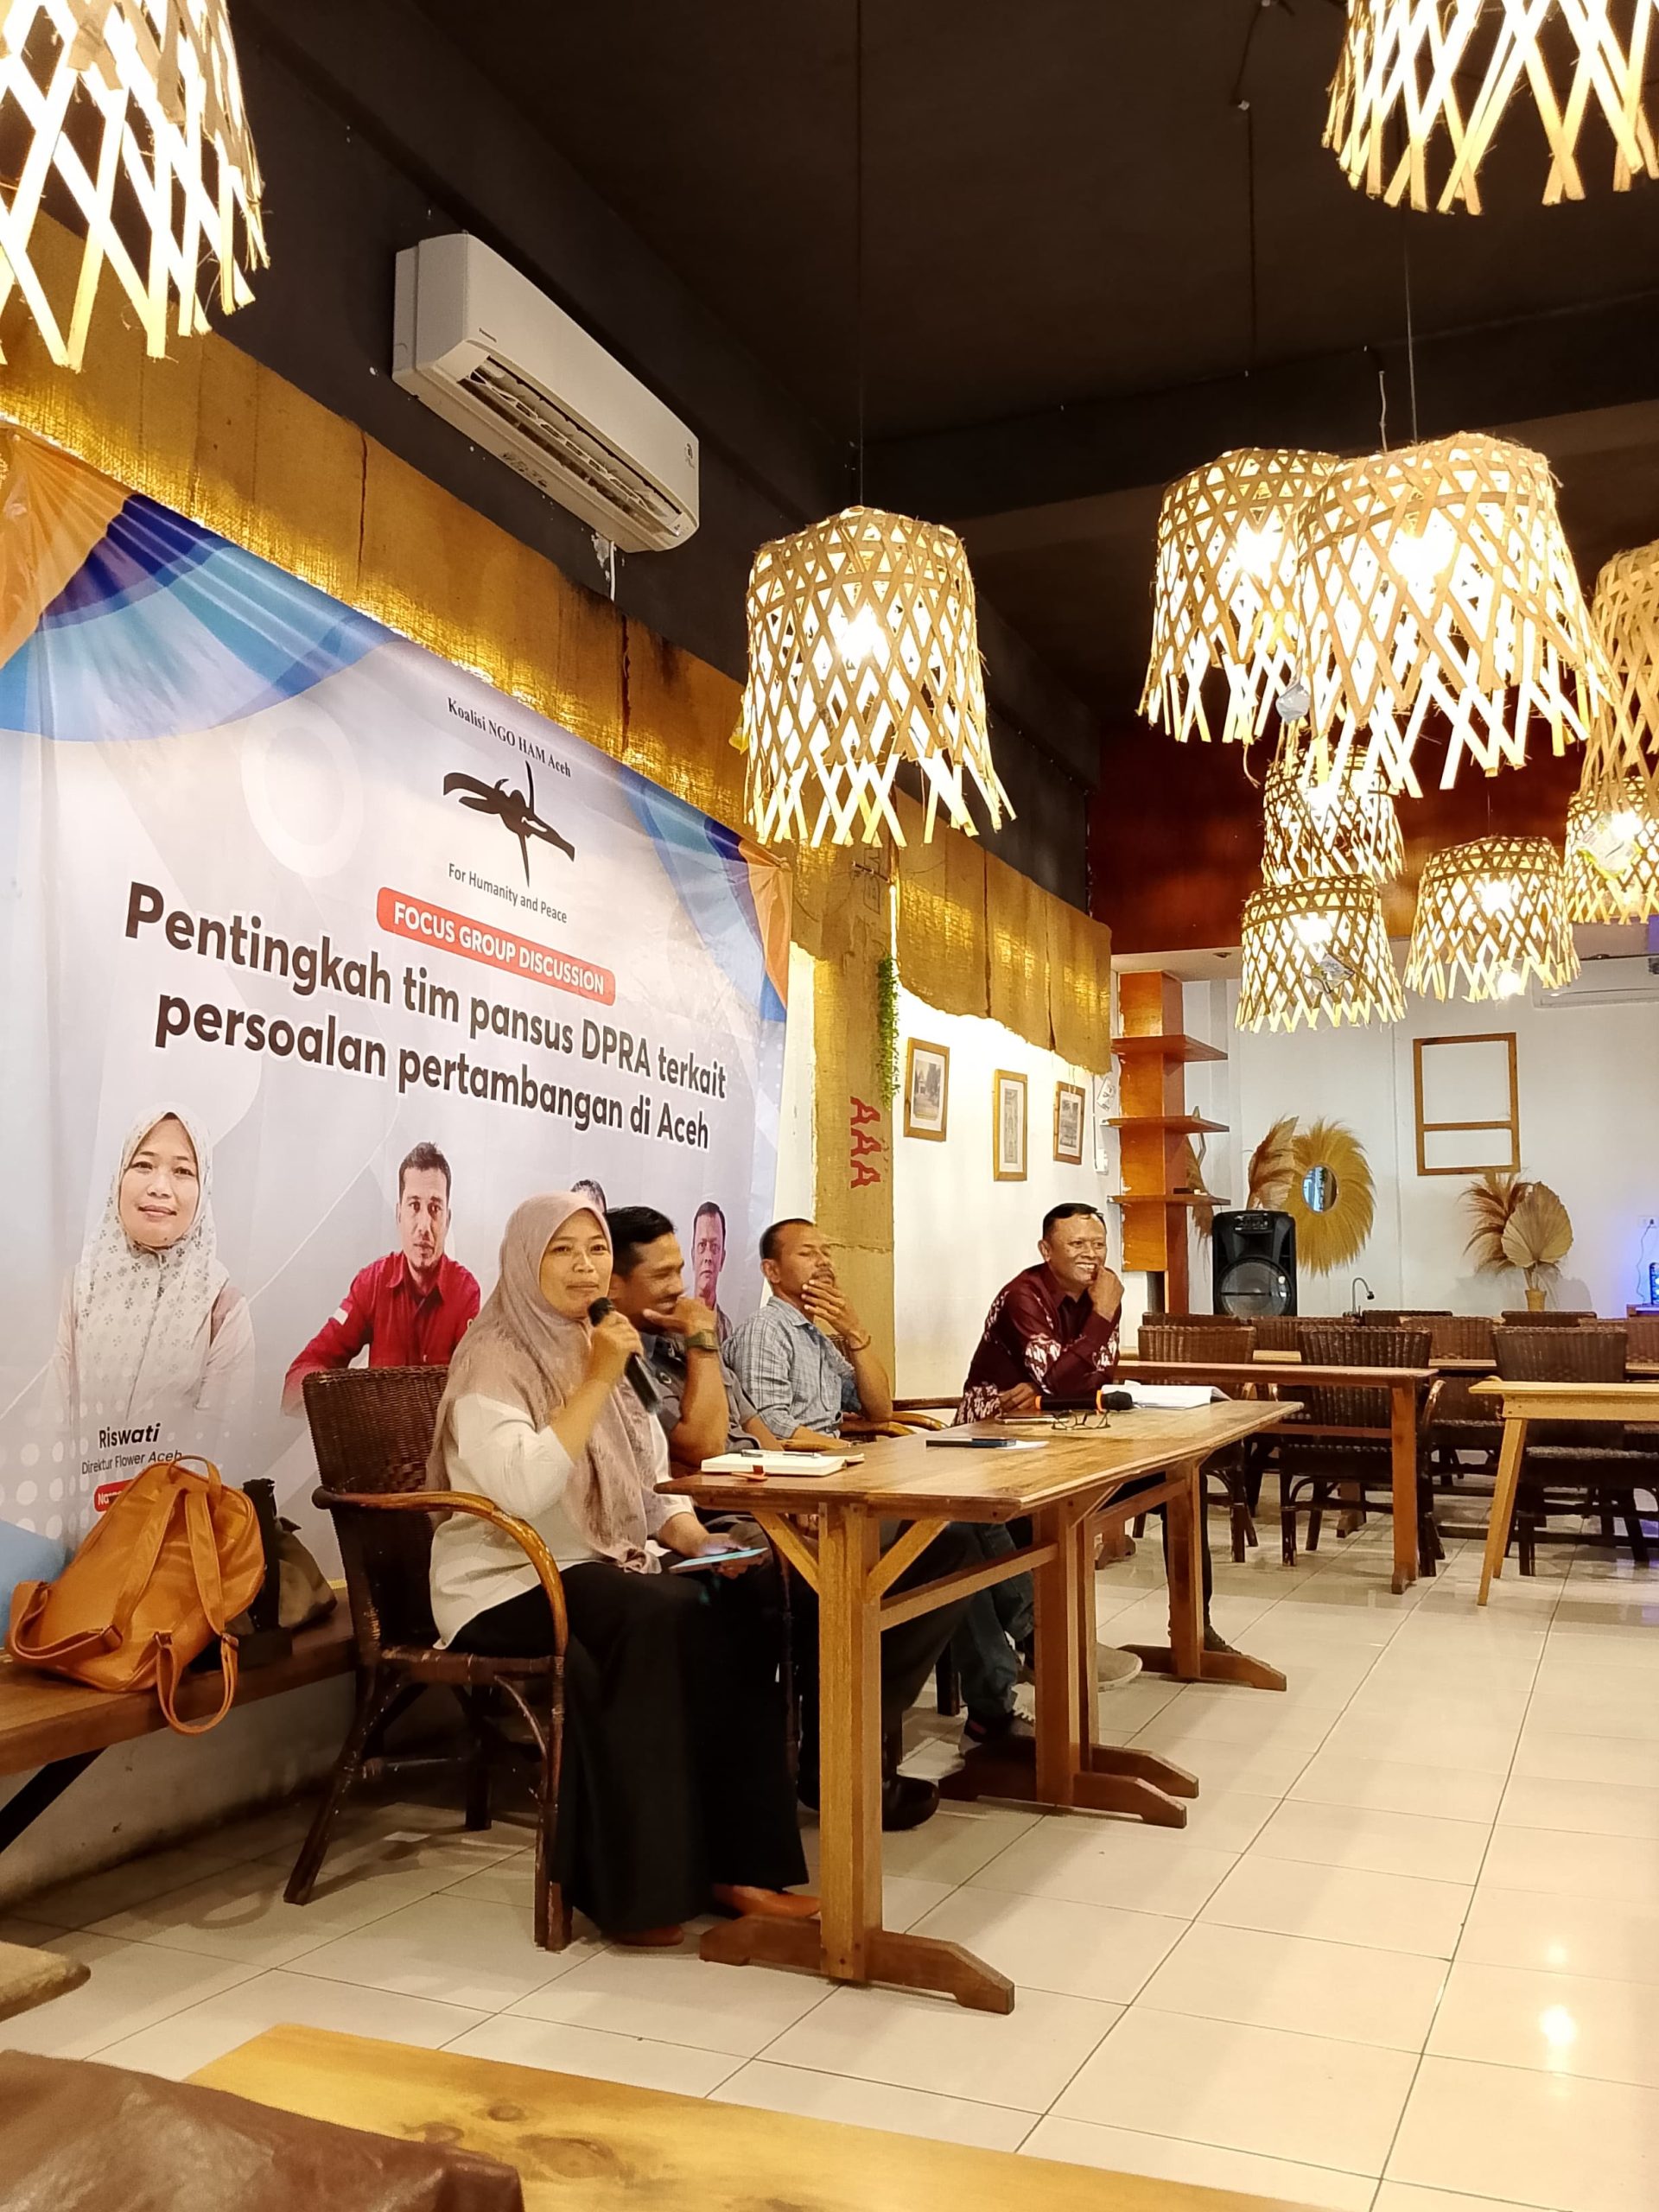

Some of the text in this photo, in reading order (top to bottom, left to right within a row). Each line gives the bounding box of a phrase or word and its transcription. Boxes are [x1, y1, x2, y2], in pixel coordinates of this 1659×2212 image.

[448, 697, 571, 778] Koalisi NGO HAM Aceh
[448, 863, 568, 924] For Humanity and Peace
[394, 901, 605, 995] FOCUS GROUP DISCUSSION
[125, 881, 726, 1099] Pentingkah tim pansus DPRA terkait
[156, 994, 709, 1149] persoalan pertambangan di Aceh
[81, 1449, 182, 1475] Direktur Flower Aceh
[99, 1422, 162, 1449] Riswati
